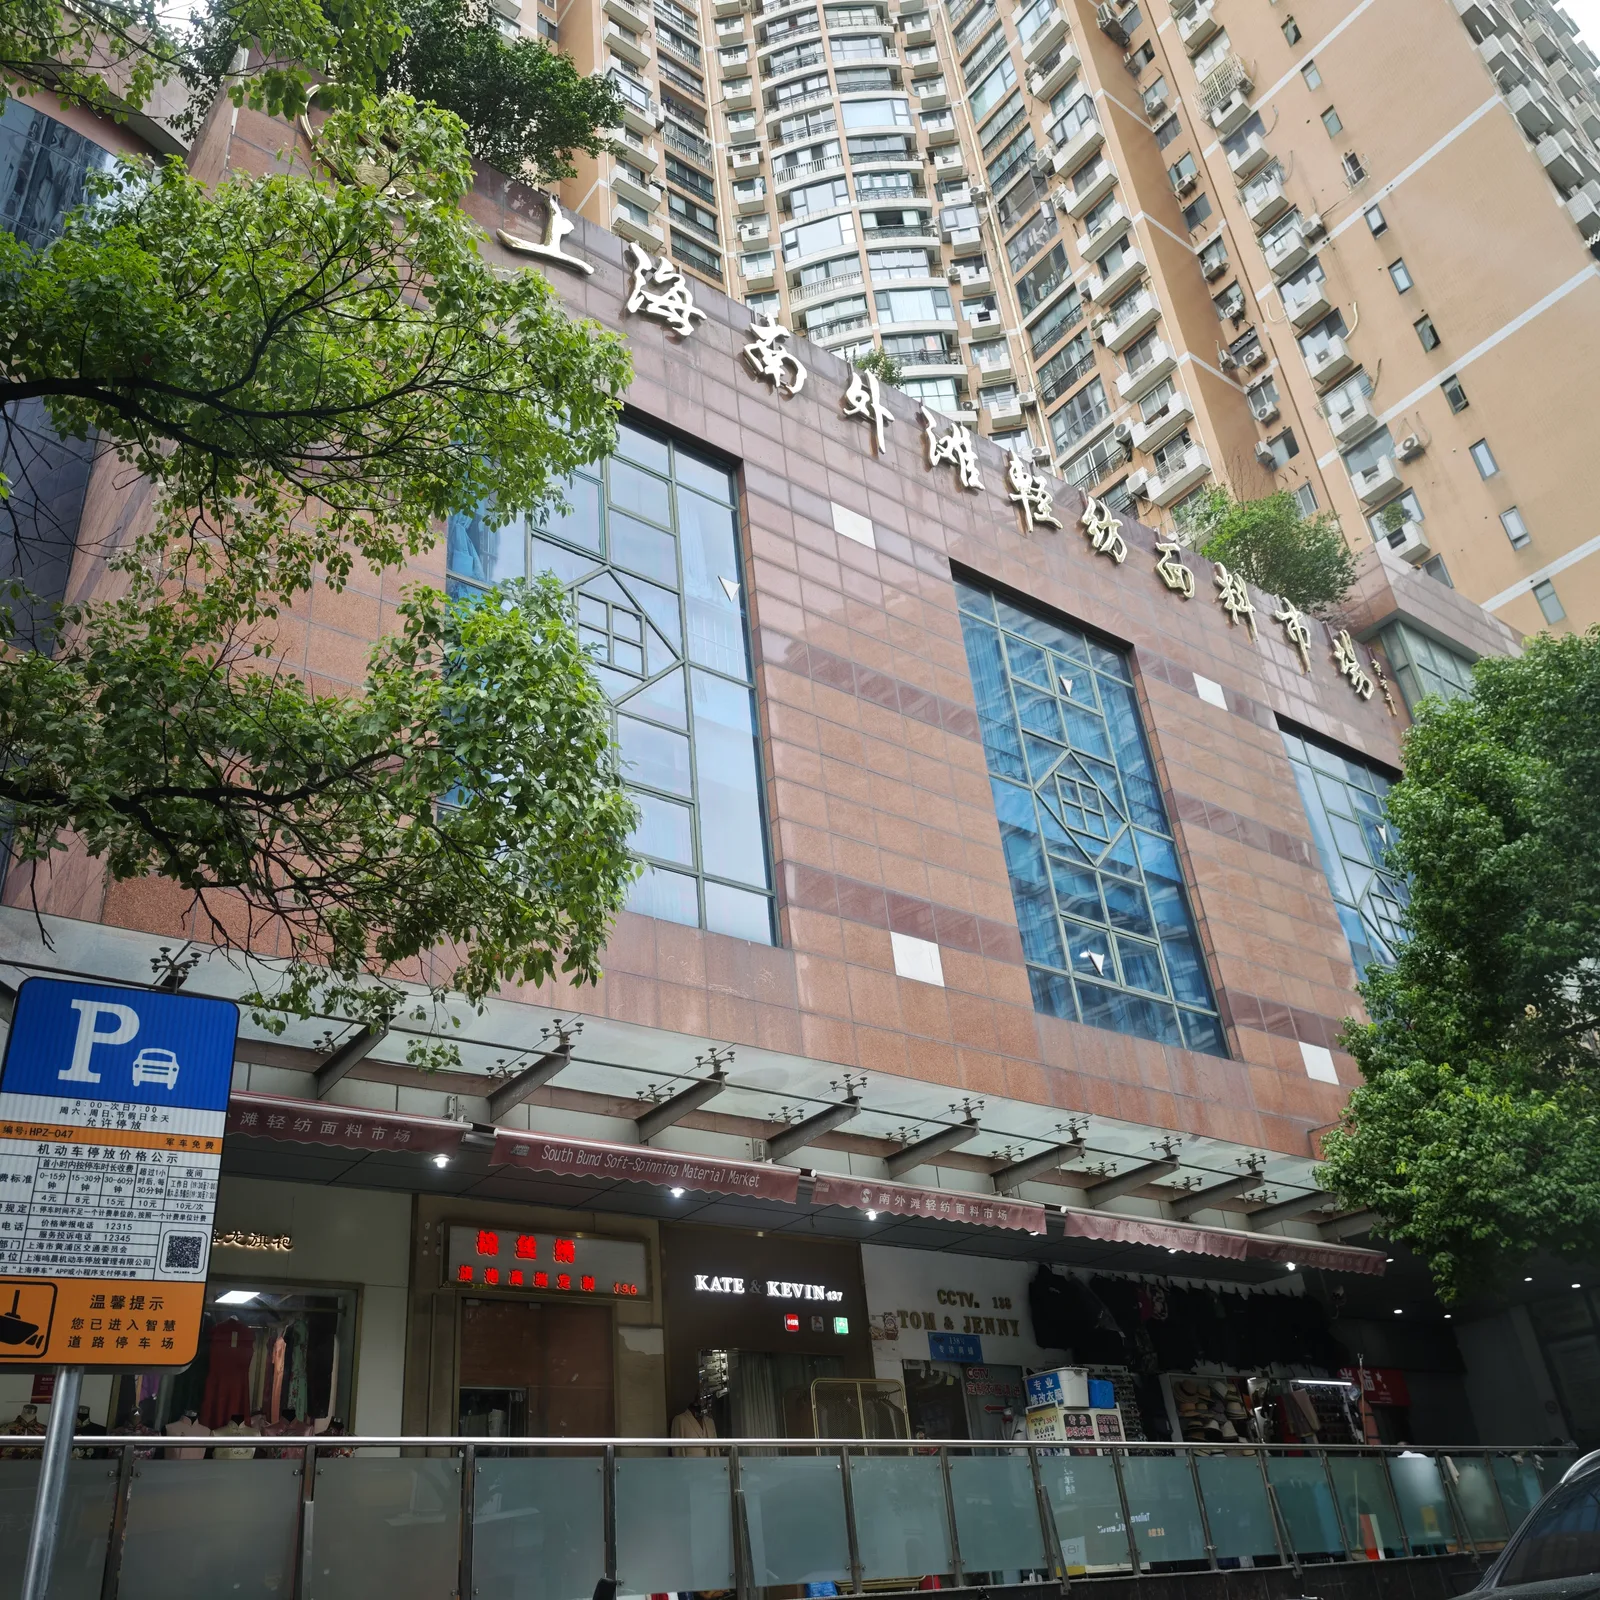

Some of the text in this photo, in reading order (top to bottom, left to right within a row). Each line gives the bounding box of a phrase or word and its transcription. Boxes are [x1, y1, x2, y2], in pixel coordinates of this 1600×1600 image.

[58, 999, 140, 1083] P
[86, 1118, 141, 1130] 允许停放
[227, 1110, 411, 1142] 滩轻纺面料市场
[166, 1137, 214, 1150] 军车免费
[38, 1143, 178, 1164] 机动车停放价格公示
[43, 1158, 134, 1174] 首小时内按停车时长收费
[541, 1145, 573, 1163] South
[576, 1147, 601, 1166] Bund
[604, 1154, 678, 1177] Soft-Spinning
[681, 1164, 725, 1183] Material
[727, 1169, 760, 1188] Market
[186, 1168, 203, 1178] 夜间
[41, 1194, 57, 1203] 4元
[74, 1196, 91, 1205] 8元
[106, 1198, 125, 1207] 15元
[139, 1200, 157, 1209] 10元
[0, 1203, 28, 1213] 规定
[176, 1203, 204, 1211] 10元/次
[878, 1192, 1008, 1221] 南外滩轻纺面料市场
[2, 1221, 24, 1231] 电话
[41, 1219, 133, 1231] 价格举报电话 12315
[39, 1230, 131, 1242] 服务投诉电话 12345
[26, 1241, 127, 1254] 上海市黄浦区交通委员会
[695, 1275, 745, 1294] KATE
[749, 1279, 762, 1294] &
[766, 1281, 826, 1300] KEVIN
[89, 1294, 164, 1311] 温馨提示
[71, 1316, 176, 1332] 您已进入智慧
[897, 1309, 1021, 1338] TOM & JENNY
[67, 1335, 174, 1350] 道路停车场
[1033, 1377, 1054, 1391] 专业
[1030, 1388, 1064, 1406] 修改衣服
